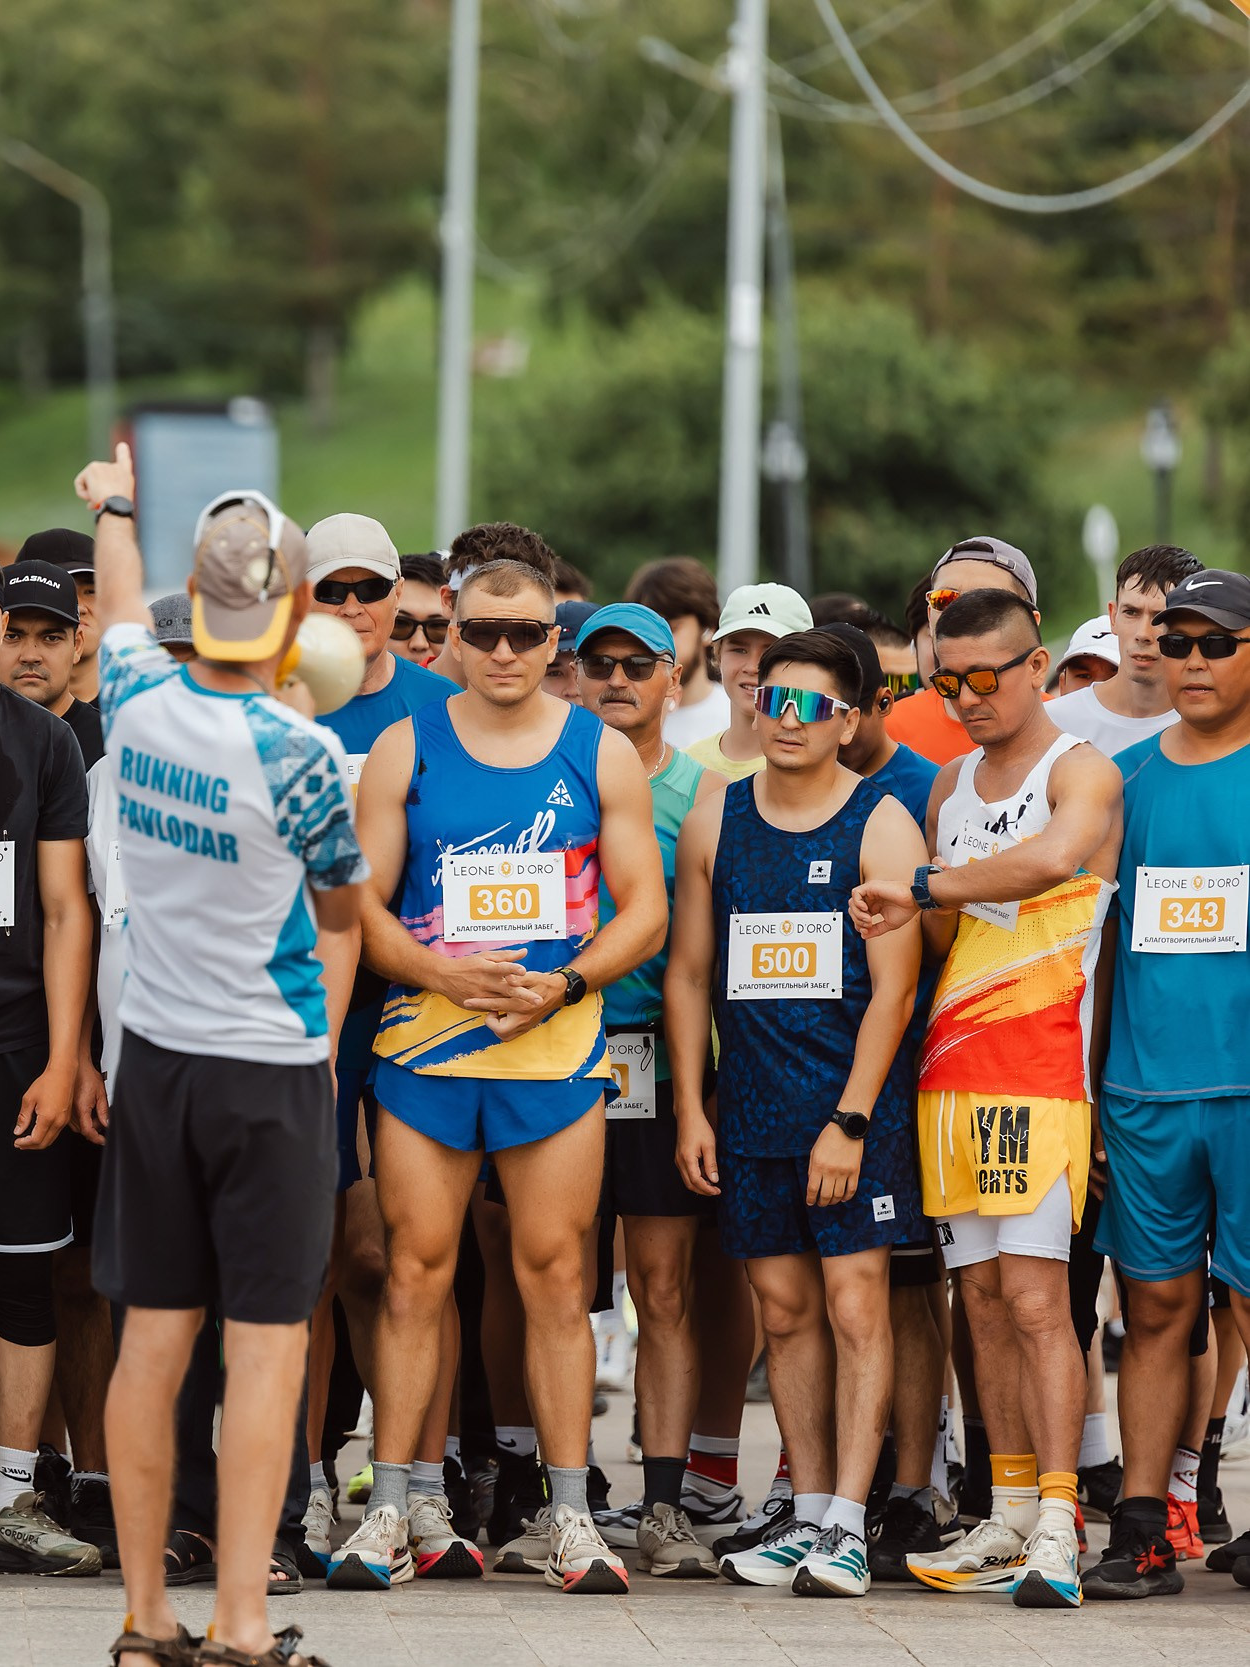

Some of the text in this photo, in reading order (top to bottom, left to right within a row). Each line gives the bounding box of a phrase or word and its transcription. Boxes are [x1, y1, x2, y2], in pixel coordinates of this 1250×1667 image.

[9, 575, 61, 590] GLASMAN
[119, 745, 230, 815] RUNNING
[118, 792, 239, 864] PAVLODAR
[963, 835, 989, 853] LEONE
[453, 864, 554, 876] LEONE D'ORO
[1146, 877, 1240, 889] LEONE D'ORO
[476, 888, 533, 916] 360
[1166, 901, 1219, 928] 343
[456, 923, 533, 932] БЛАГОТВОРИТЕЛЬНЫЙ
[739, 923, 832, 935] LEONE D'ORO
[1144, 936, 1216, 944] БЛАГОТВОРИТЕЛЬНЫЙ
[758, 947, 810, 974] 500
[738, 982, 809, 990] БЛАГОТВОРИТЕЛЬНЫЙ
[607, 1044, 644, 1055] D'ORO
[971, 1106, 1031, 1164] YM
[976, 1169, 1028, 1194] ORTS
[0, 1526, 39, 1545] CORDURA
